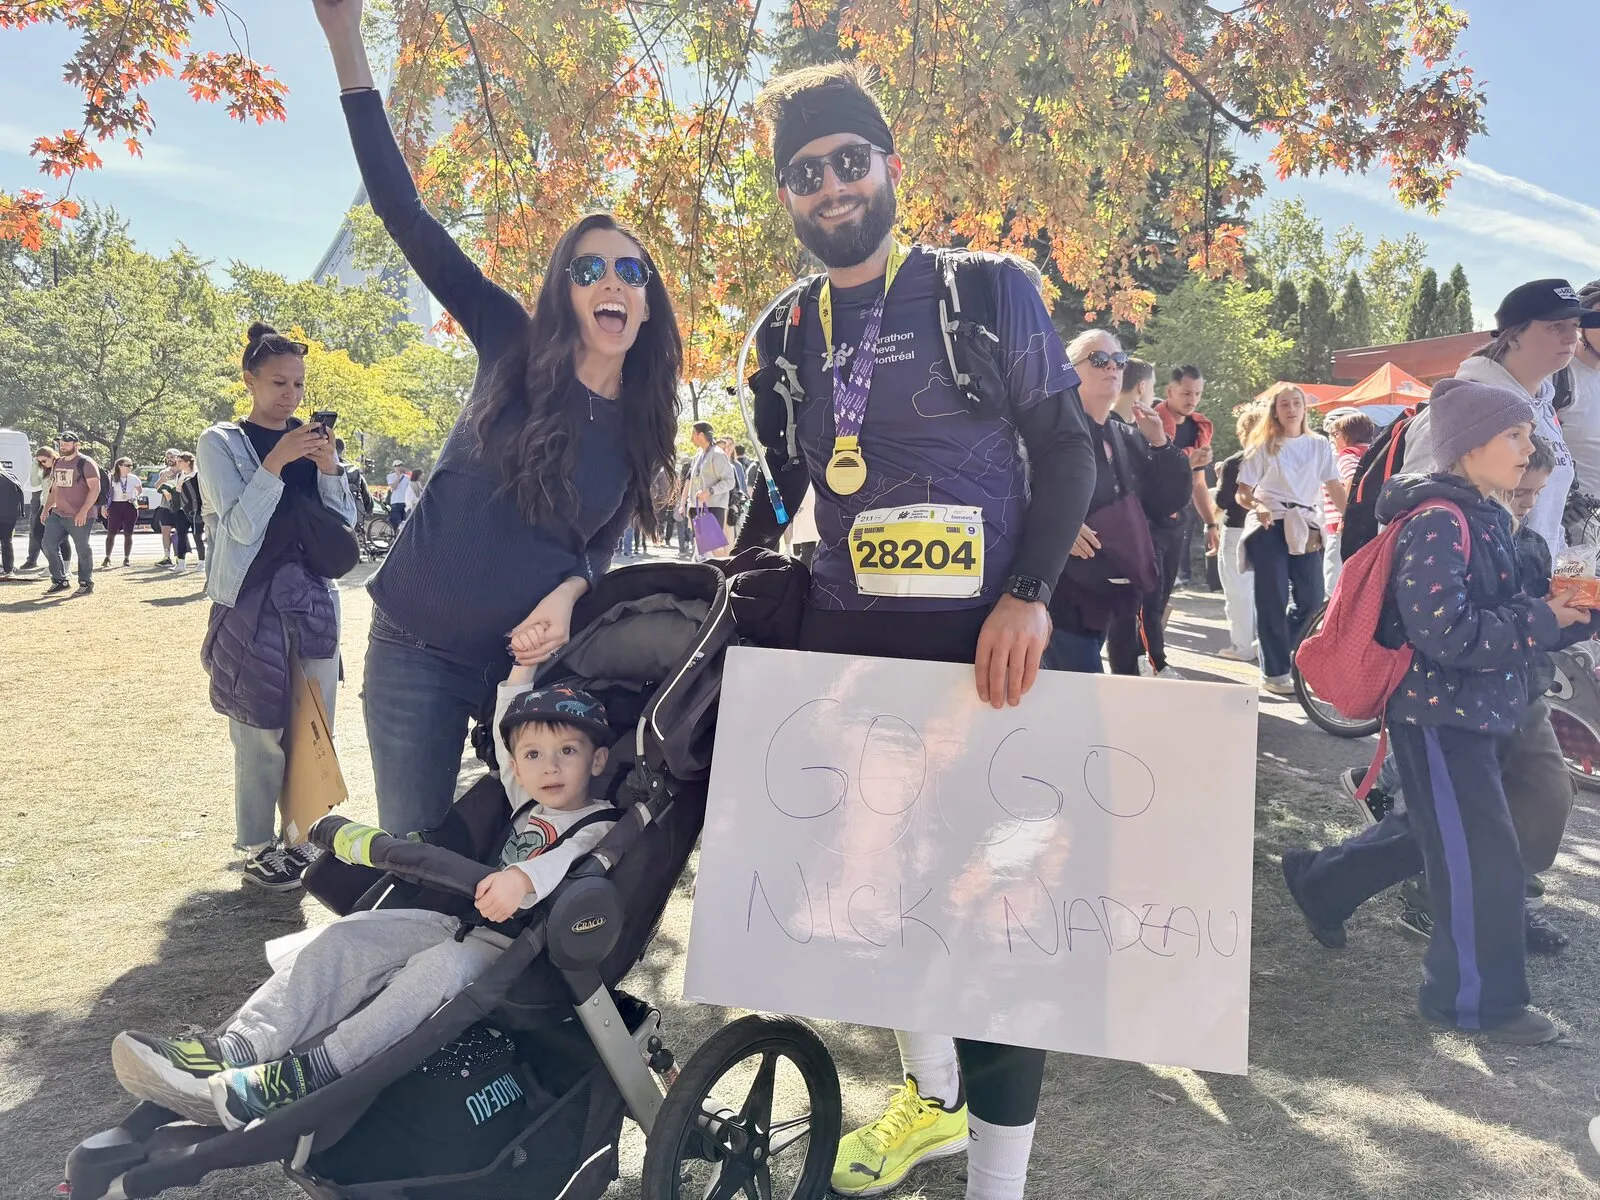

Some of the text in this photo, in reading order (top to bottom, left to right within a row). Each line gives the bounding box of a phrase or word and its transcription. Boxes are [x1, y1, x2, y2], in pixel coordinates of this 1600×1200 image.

[968, 526, 976, 535] 9
[856, 539, 976, 570] 28204
[765, 698, 1156, 822] GO GO
[574, 917, 604, 931] GRACO
[746, 861, 1239, 958] NICK NADEAU
[465, 1072, 523, 1126] NADEAU
